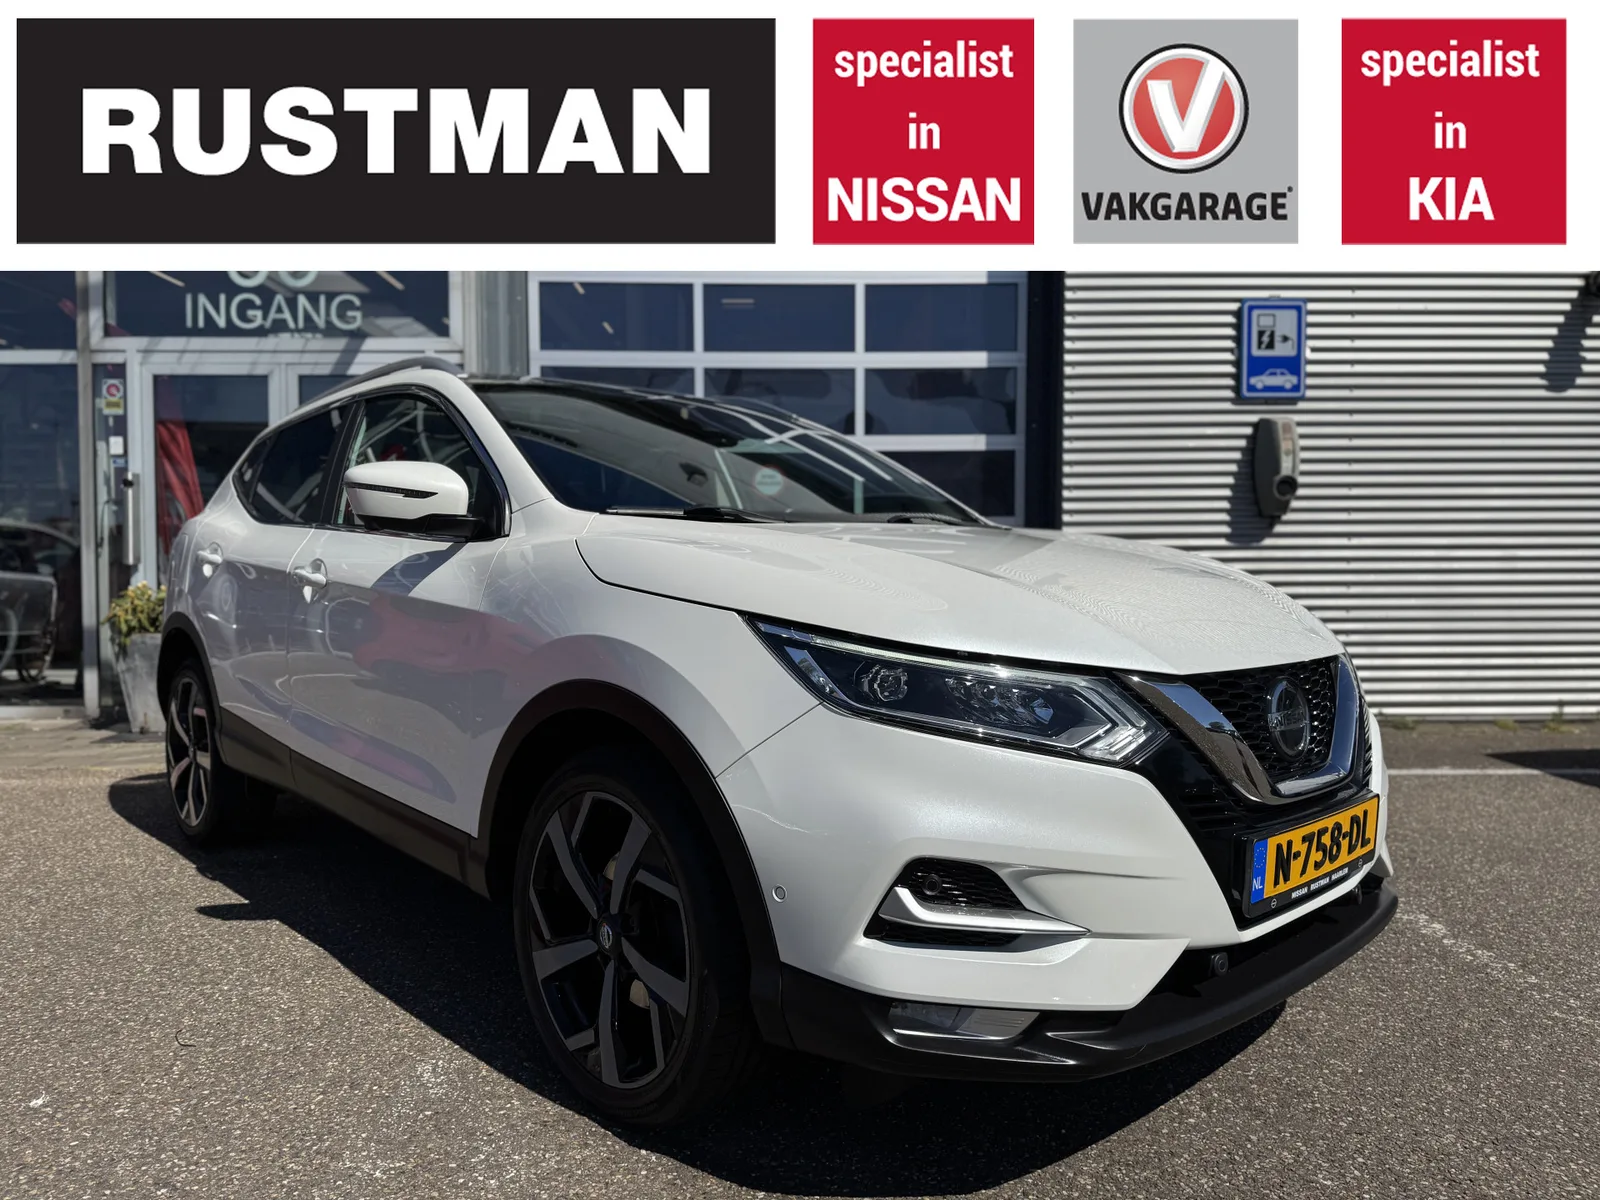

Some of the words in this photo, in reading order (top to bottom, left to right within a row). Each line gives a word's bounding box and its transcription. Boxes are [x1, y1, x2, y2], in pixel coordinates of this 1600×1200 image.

[184, 293, 364, 330] INGANG
[1273, 808, 1371, 888] N-758-DL
[1252, 876, 1263, 891] NL
[1291, 886, 1308, 899] NISSAN
[1310, 876, 1330, 891] RUSTMAN
